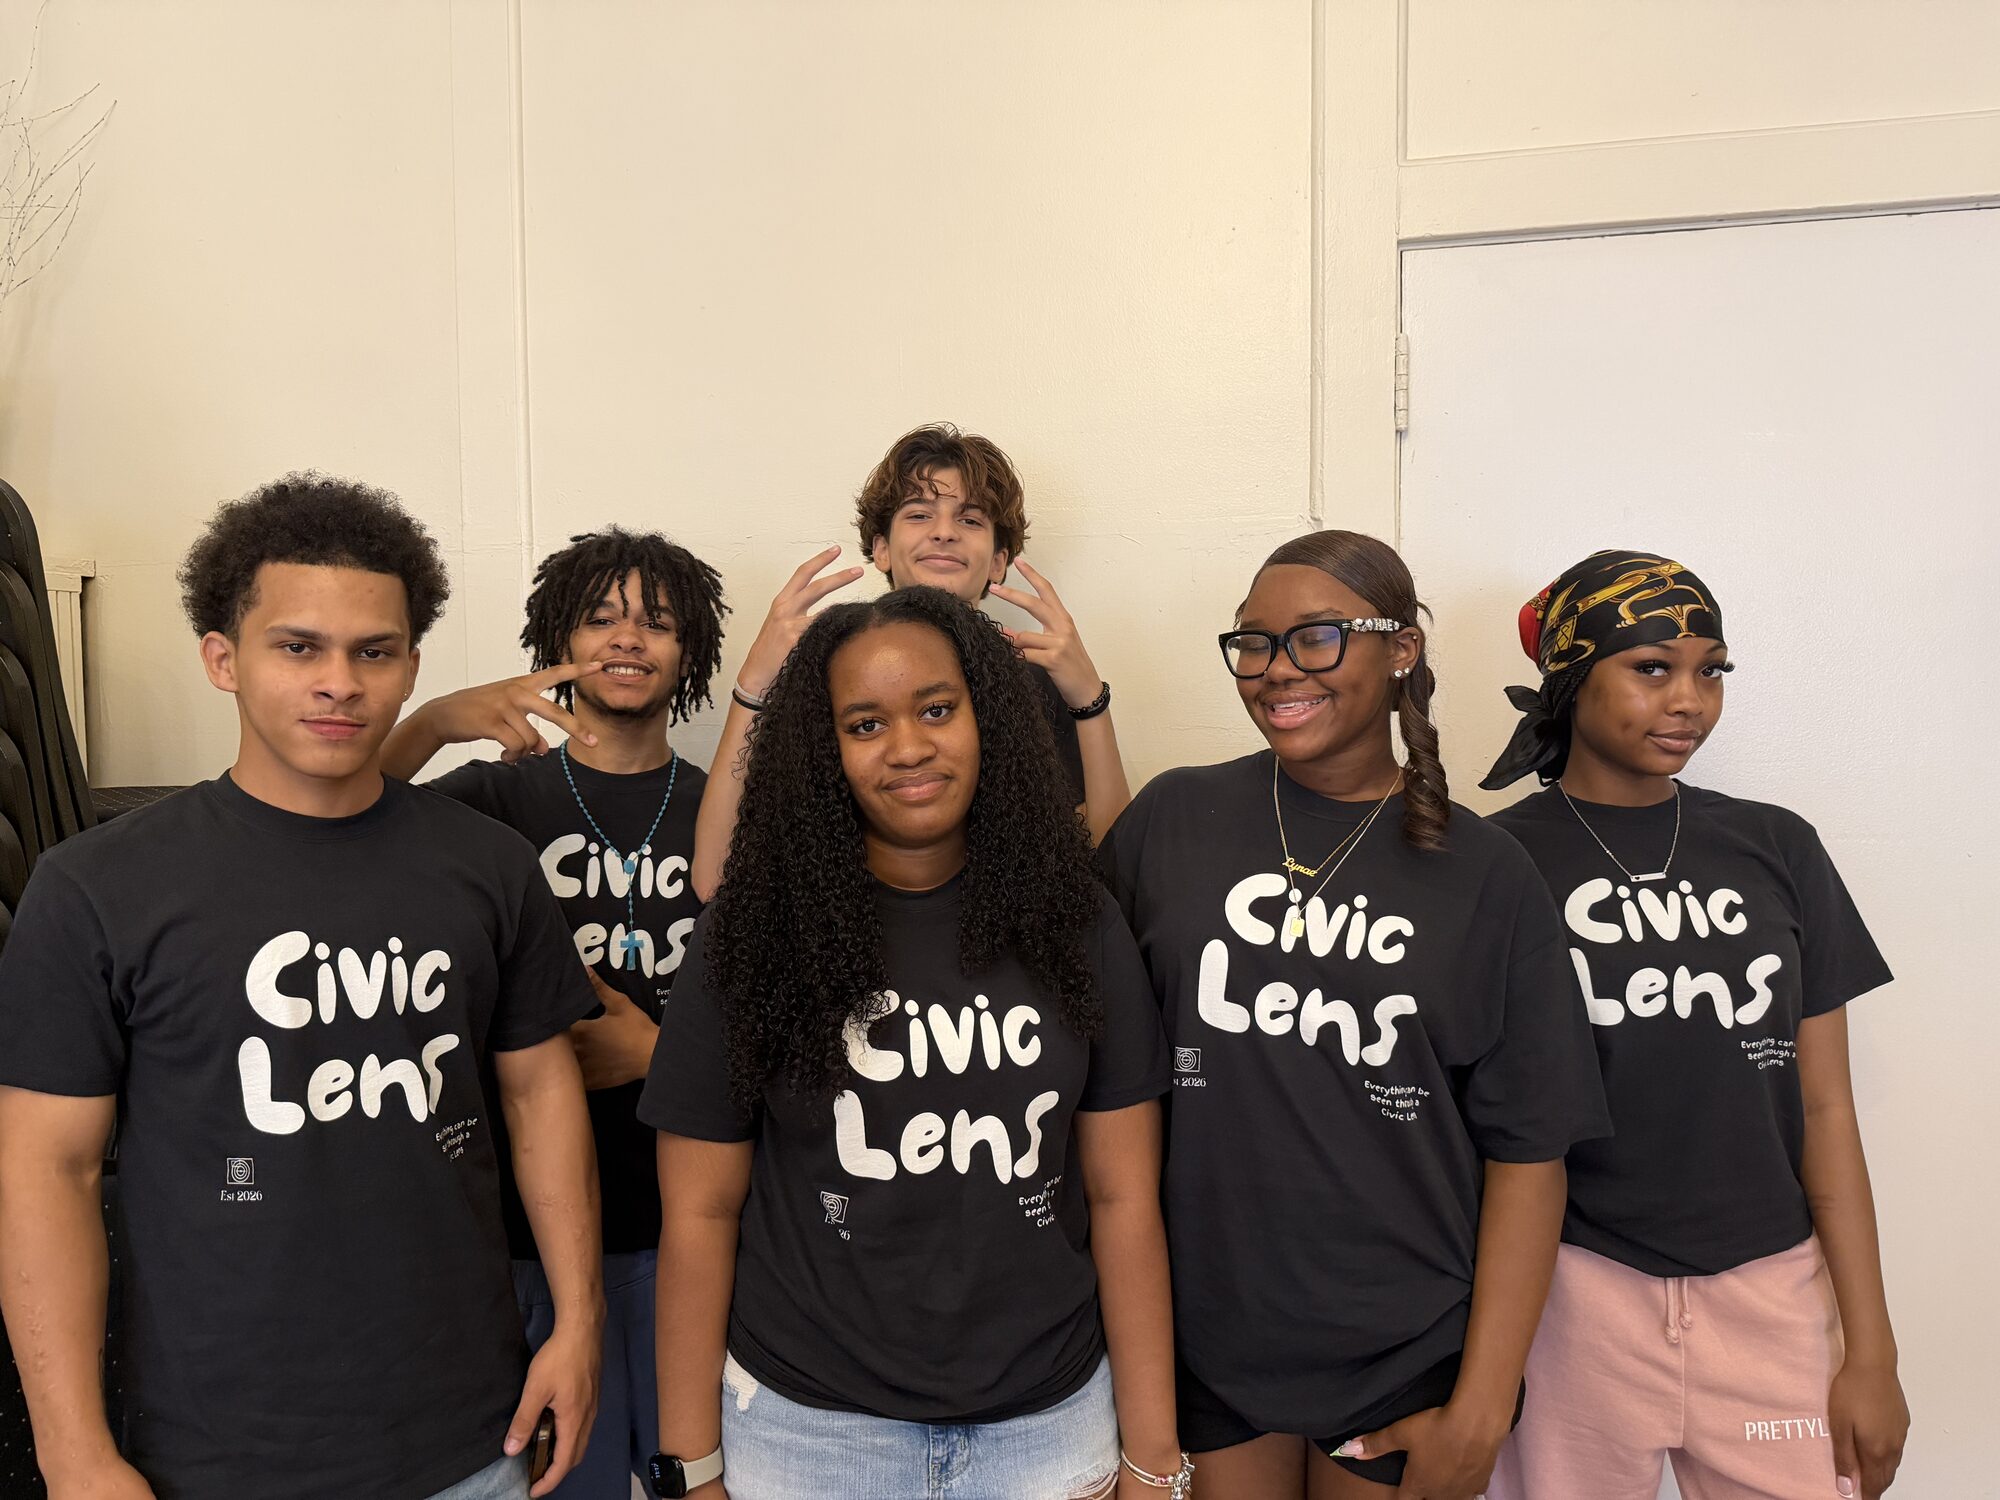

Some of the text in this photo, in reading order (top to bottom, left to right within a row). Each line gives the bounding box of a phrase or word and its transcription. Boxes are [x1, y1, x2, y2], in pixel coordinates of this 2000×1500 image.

[539, 834, 689, 899] Civic
[1281, 857, 1318, 878] Lynae
[1225, 873, 1414, 965] Civic
[1565, 870, 1748, 944] Civic
[246, 931, 453, 1029] Civic
[573, 918, 696, 979] ens
[1198, 939, 1418, 1067] Lens
[1569, 948, 1783, 1030] Lens
[842, 988, 1042, 1082] Civic
[238, 1034, 460, 1121] Lens
[1181, 1077, 1207, 1088] 2026
[1370, 1094, 1392, 1106] seen
[1414, 1099, 1420, 1107] a
[1418, 1087, 1430, 1097] be
[467, 1118, 478, 1127] be
[834, 1090, 1060, 1185] Lens
[1381, 1107, 1405, 1121] Civic
[220, 1190, 263, 1202] Est 2026
[1025, 1205, 1047, 1218] seen
